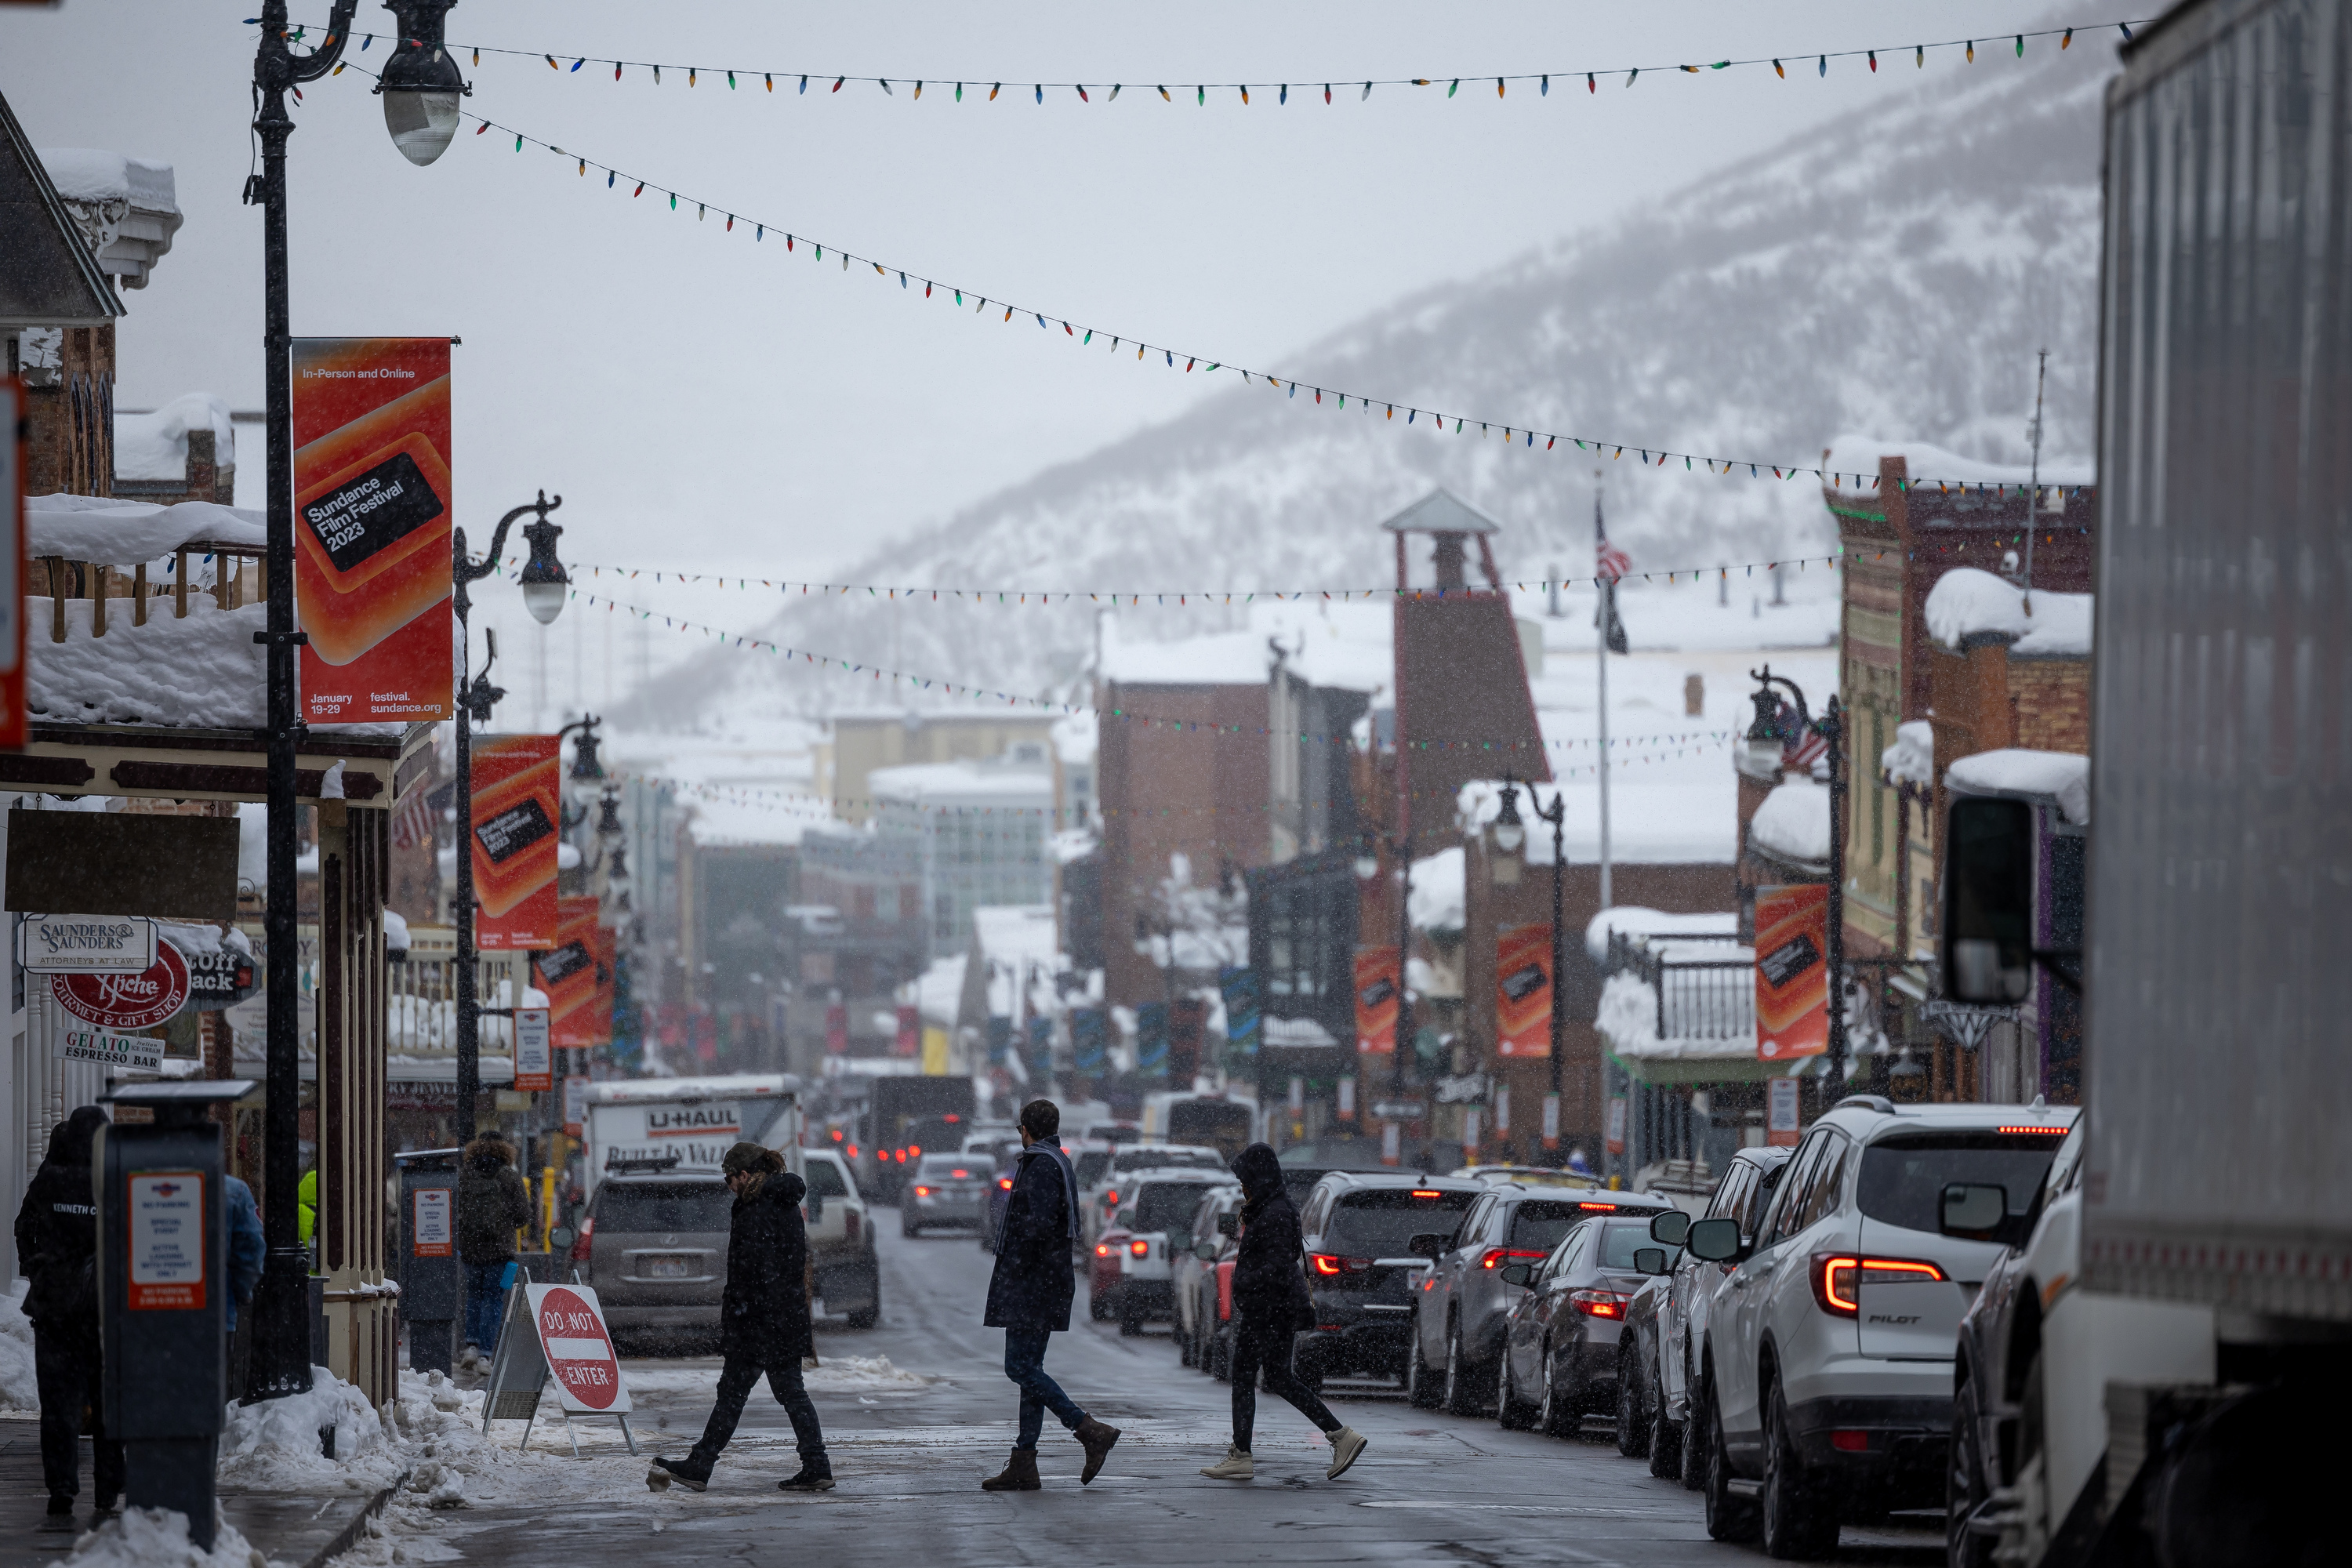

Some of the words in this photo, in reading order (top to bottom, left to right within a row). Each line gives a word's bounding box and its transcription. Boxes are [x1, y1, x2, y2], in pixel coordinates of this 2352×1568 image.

[303, 368, 355, 378] In-Person
[358, 368, 378, 378] and
[379, 368, 416, 378] Online
[308, 478, 381, 523] Sundance
[316, 514, 352, 538] Film
[348, 480, 405, 519] Festival
[326, 521, 365, 553] 2023
[310, 694, 353, 706] January
[370, 691, 410, 702] festival.
[310, 704, 341, 714] 19-29
[371, 703, 441, 713] sundance.org
[49, 936, 124, 953] SAUNDERS
[191, 973, 234, 991] ack
[103, 1014, 114, 1025] &
[118, 1013, 148, 1026] GIFT
[153, 989, 181, 1021] SHOP
[67, 1032, 130, 1053] GELATO
[65, 1047, 128, 1064] ESPRESSO
[133, 1055, 158, 1068] BAR
[649, 1109, 737, 1127] U-HAUL
[53, 1203, 89, 1214] KENNETH
[544, 1312, 564, 1330] DO
[568, 1312, 594, 1331] NOT
[1868, 1315, 1922, 1324] PILOT
[566, 1367, 609, 1385] ENTER
